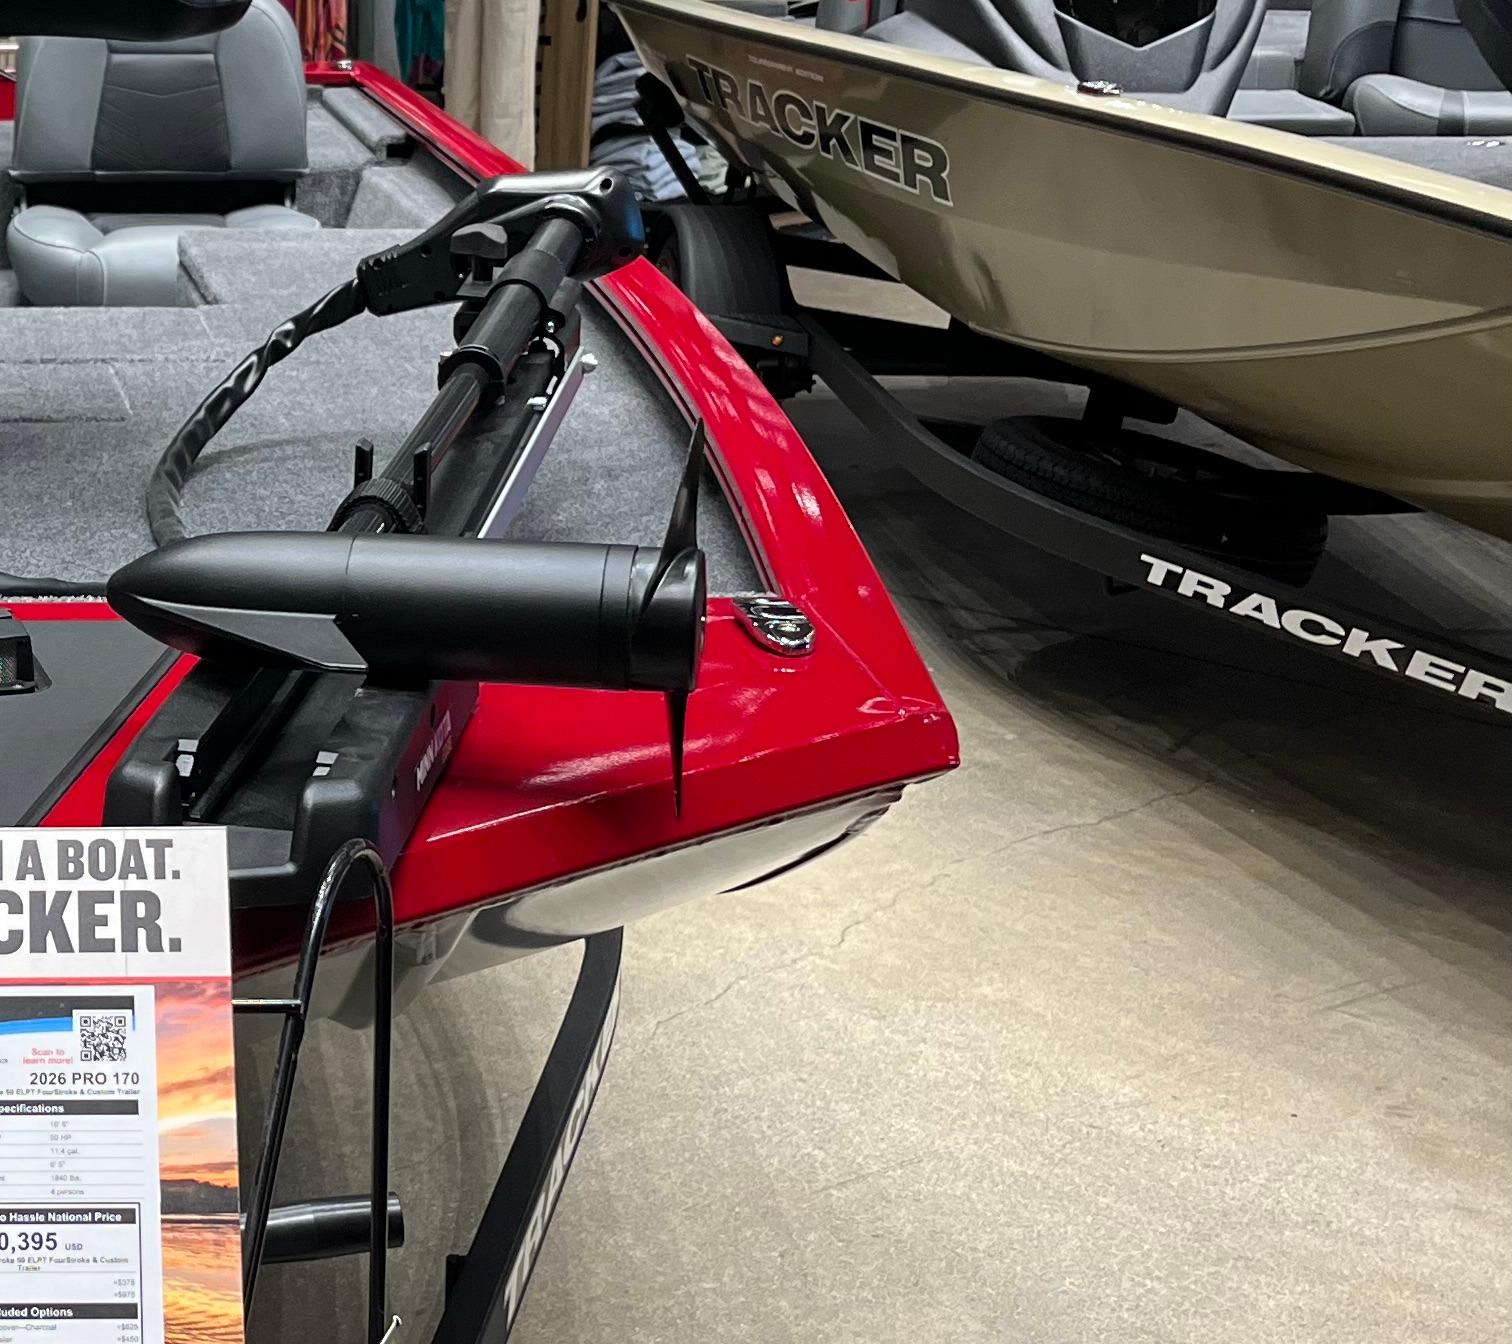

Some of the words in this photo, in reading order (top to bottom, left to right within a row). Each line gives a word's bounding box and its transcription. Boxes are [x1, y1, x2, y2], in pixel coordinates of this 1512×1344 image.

[685, 54, 954, 206] TRACKER
[1140, 553, 1512, 714] TRACKER
[15, 839, 46, 881] A
[56, 838, 181, 880] BOAT.
[32, 1048, 53, 1056] Scan
[56, 1048, 65, 1056] to
[22, 1056, 44, 1065] learn
[48, 1057, 73, 1065] more!
[30, 1072, 67, 1085] 2026
[72, 1072, 107, 1085] PRO
[113, 1072, 139, 1085] 170
[9, 1212, 45, 1222] Hassle
[47, 1212, 91, 1222] National
[94, 1212, 122, 1222] Price
[65, 1243, 83, 1251] USD
[30, 1307, 73, 1319] Options
